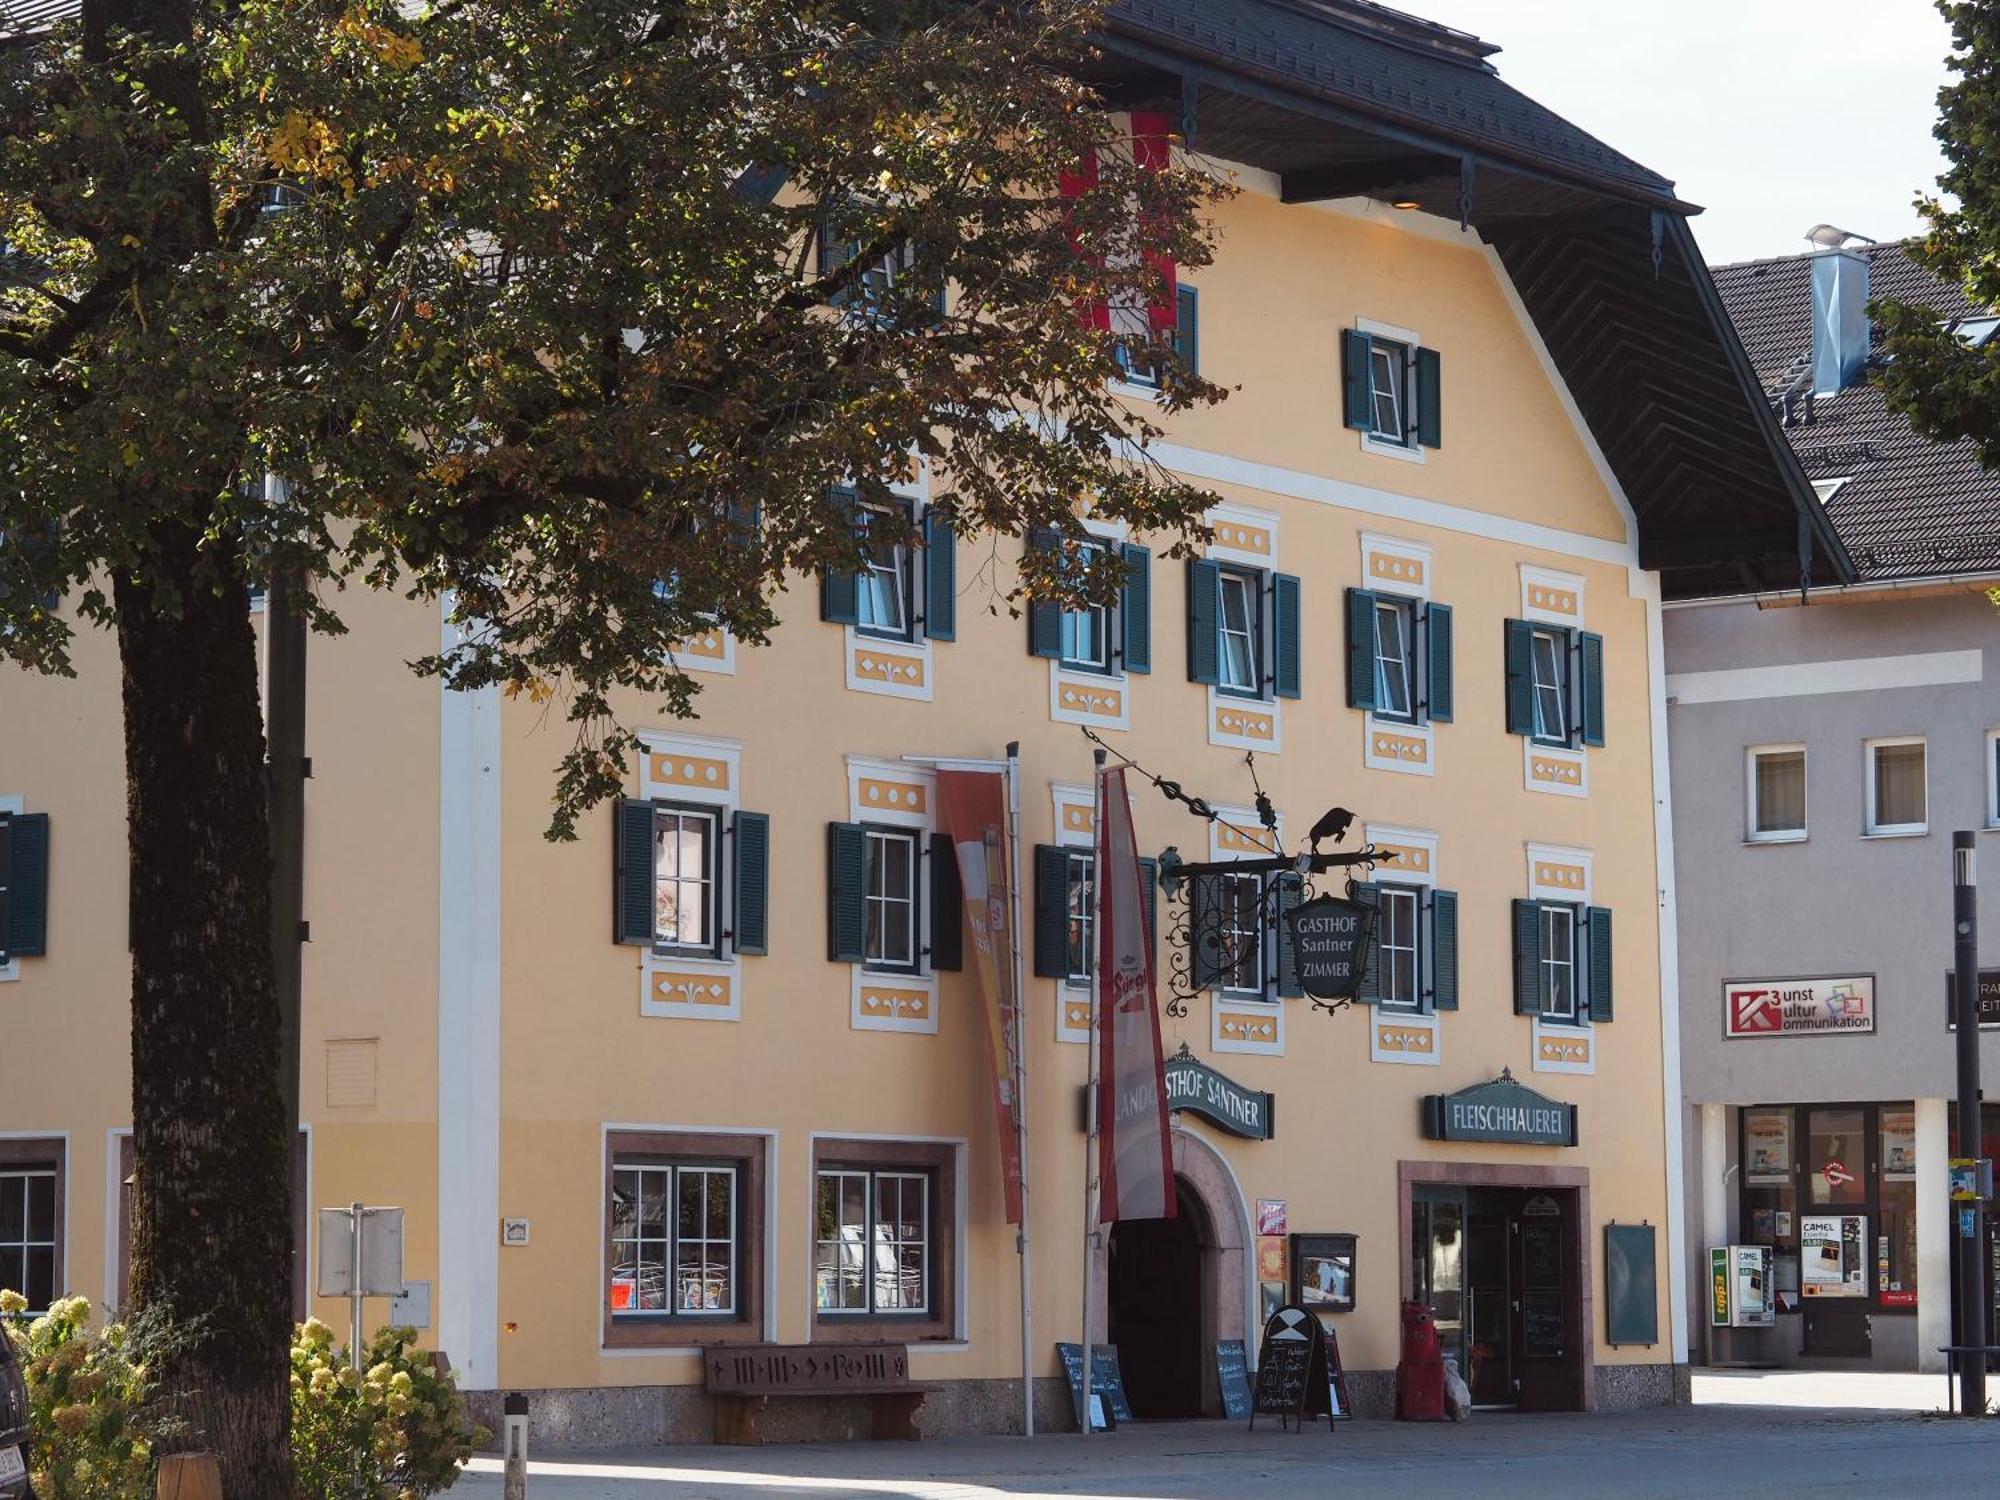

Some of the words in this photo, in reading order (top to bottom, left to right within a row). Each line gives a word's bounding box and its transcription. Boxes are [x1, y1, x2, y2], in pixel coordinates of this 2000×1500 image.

[1297, 916, 1357, 933] GASTHOF
[1302, 938, 1353, 953] Santner
[1303, 962, 1350, 977] ZIMMER
[1783, 987, 1814, 1002] unst
[1980, 983, 2000, 995] RA
[1783, 1004, 1817, 1018] ultur
[1783, 1015, 1870, 1030] ommunikation
[1207, 1077, 1259, 1128] SANTNER
[1453, 1104, 1563, 1135] FLEISCHHAUEREI
[1803, 1223, 1835, 1232] CAMEL
